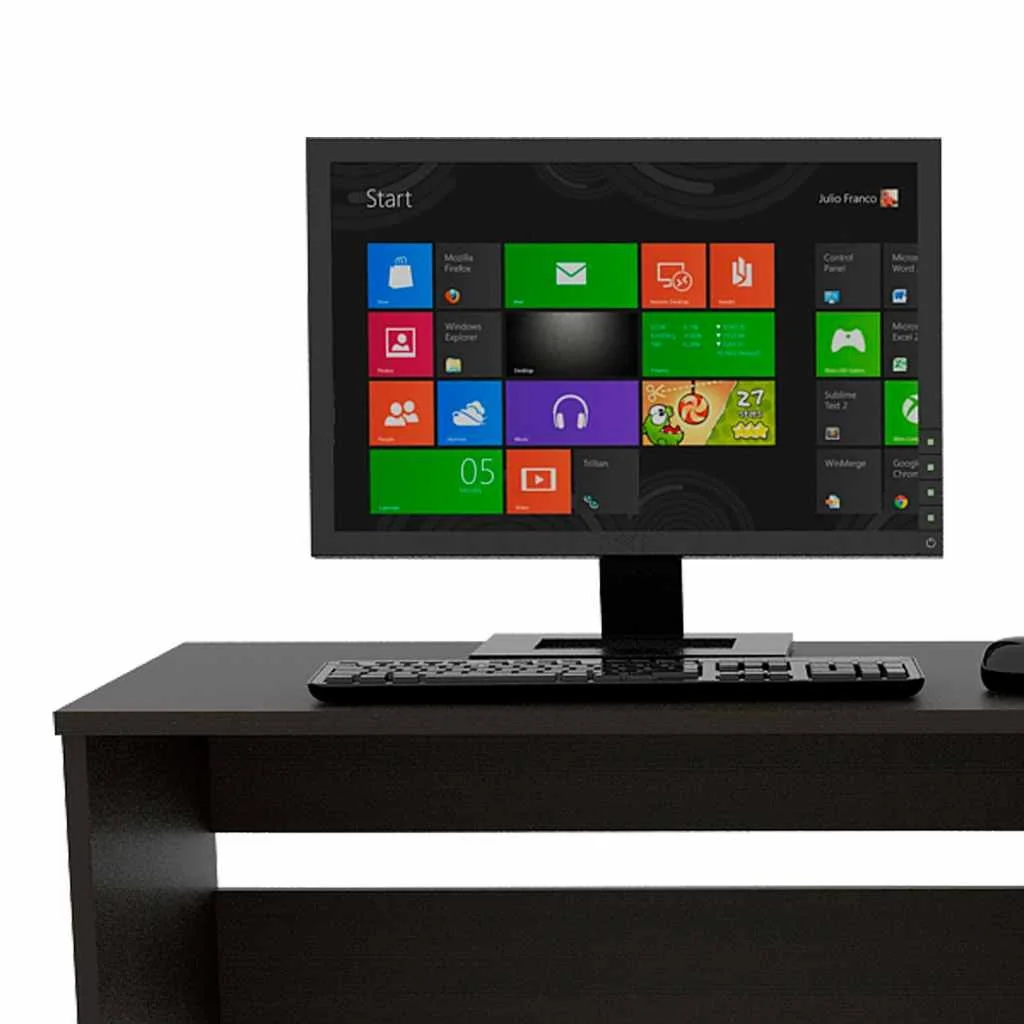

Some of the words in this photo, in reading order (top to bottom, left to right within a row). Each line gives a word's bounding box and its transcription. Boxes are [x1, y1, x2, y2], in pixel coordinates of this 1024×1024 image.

[366, 188, 413, 209] Start
[818, 193, 842, 205] Julio
[843, 193, 878, 204] Franco
[444, 252, 474, 262] Mozilla
[823, 252, 854, 262] Control
[444, 263, 472, 273] Firefox
[823, 264, 846, 273] Panel
[891, 263, 915, 273] Word
[444, 321, 482, 331] Windows
[444, 332, 478, 343] Explorer
[891, 332, 913, 342] Excel
[736, 389, 765, 408] 27
[824, 390, 857, 400] Sublime
[824, 400, 841, 410] Text
[841, 400, 849, 410] 2
[824, 459, 867, 470] WinMerge
[460, 457, 495, 485] 05
